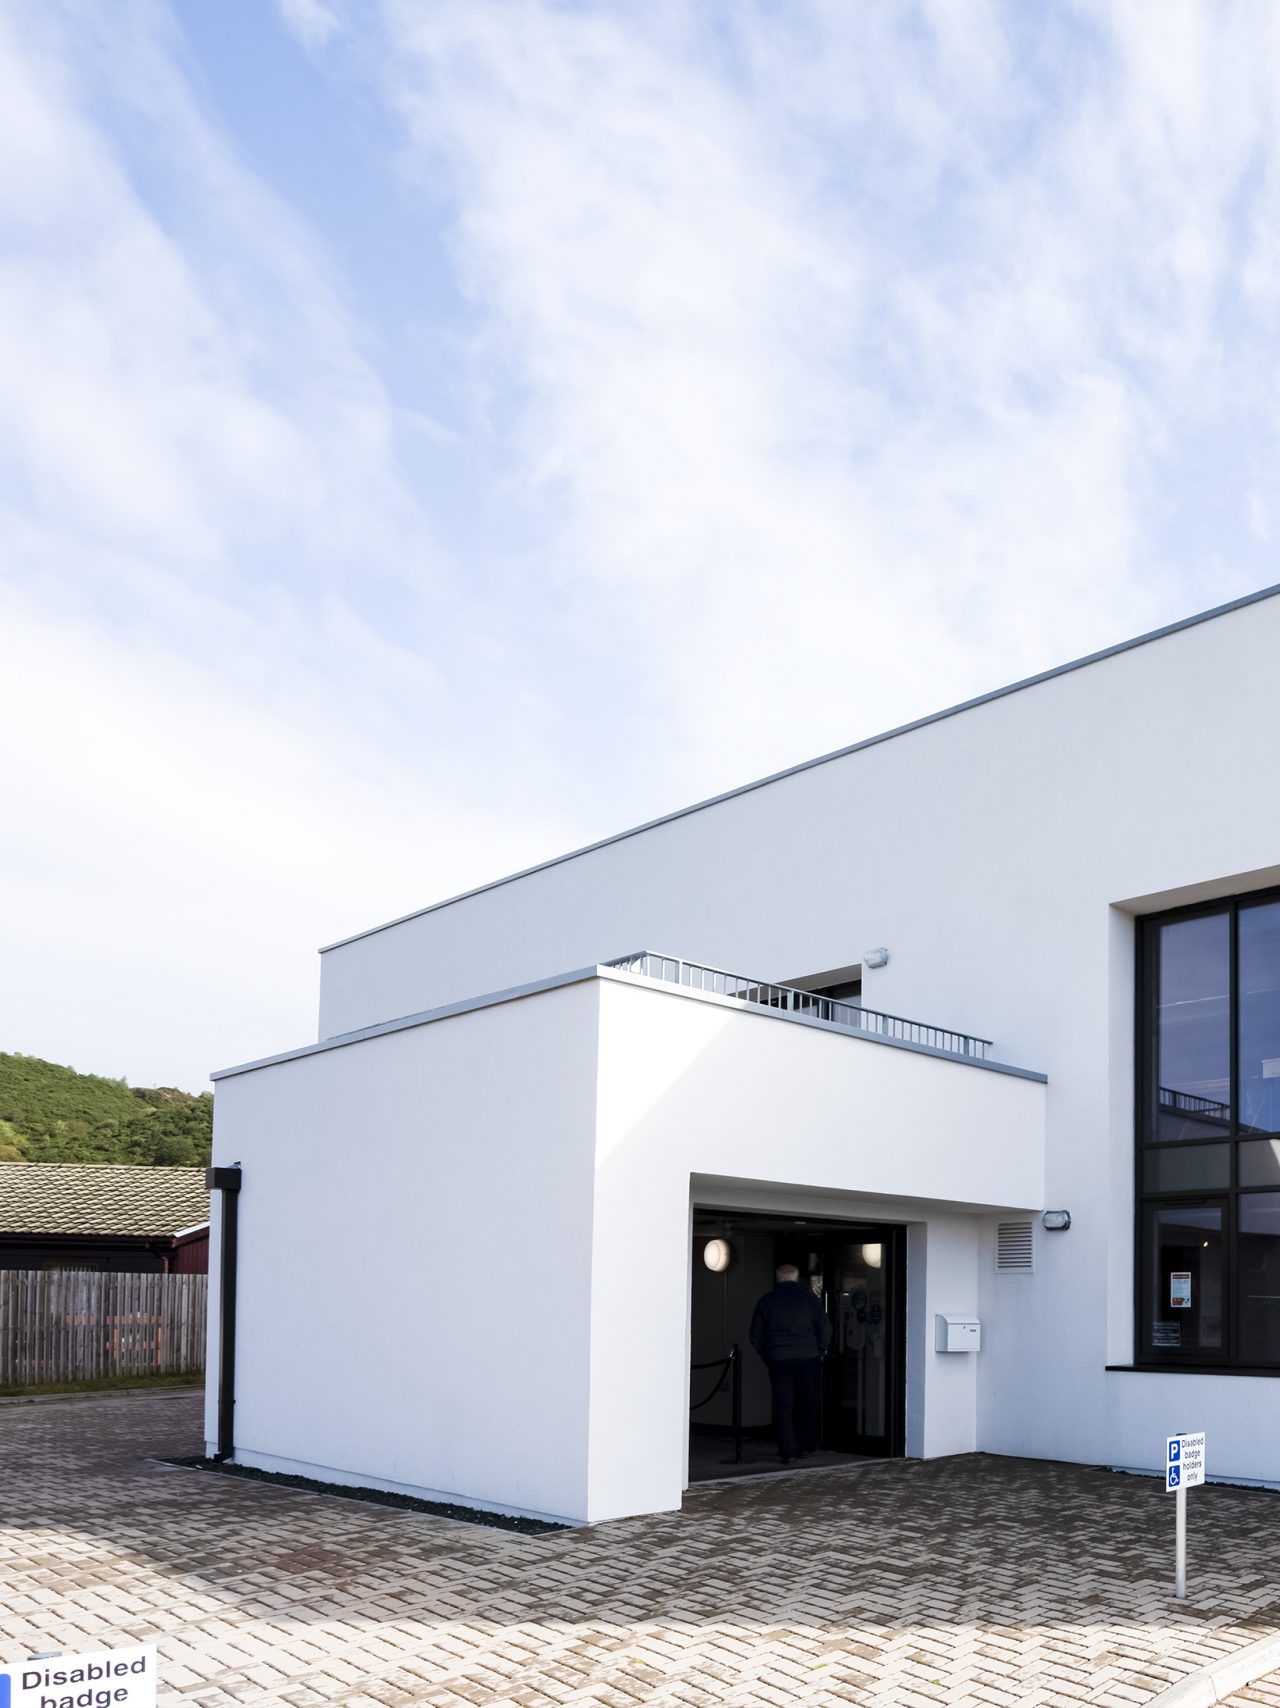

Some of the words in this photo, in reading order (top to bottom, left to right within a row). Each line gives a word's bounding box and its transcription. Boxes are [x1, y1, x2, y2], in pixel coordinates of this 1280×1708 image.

[1170, 1443, 1178, 1459] P
[1182, 1438, 1204, 1448] Disabled
[1185, 1450, 1200, 1459] badge
[22, 1655, 146, 1690] Disabled
[40, 1688, 129, 1708] badge
